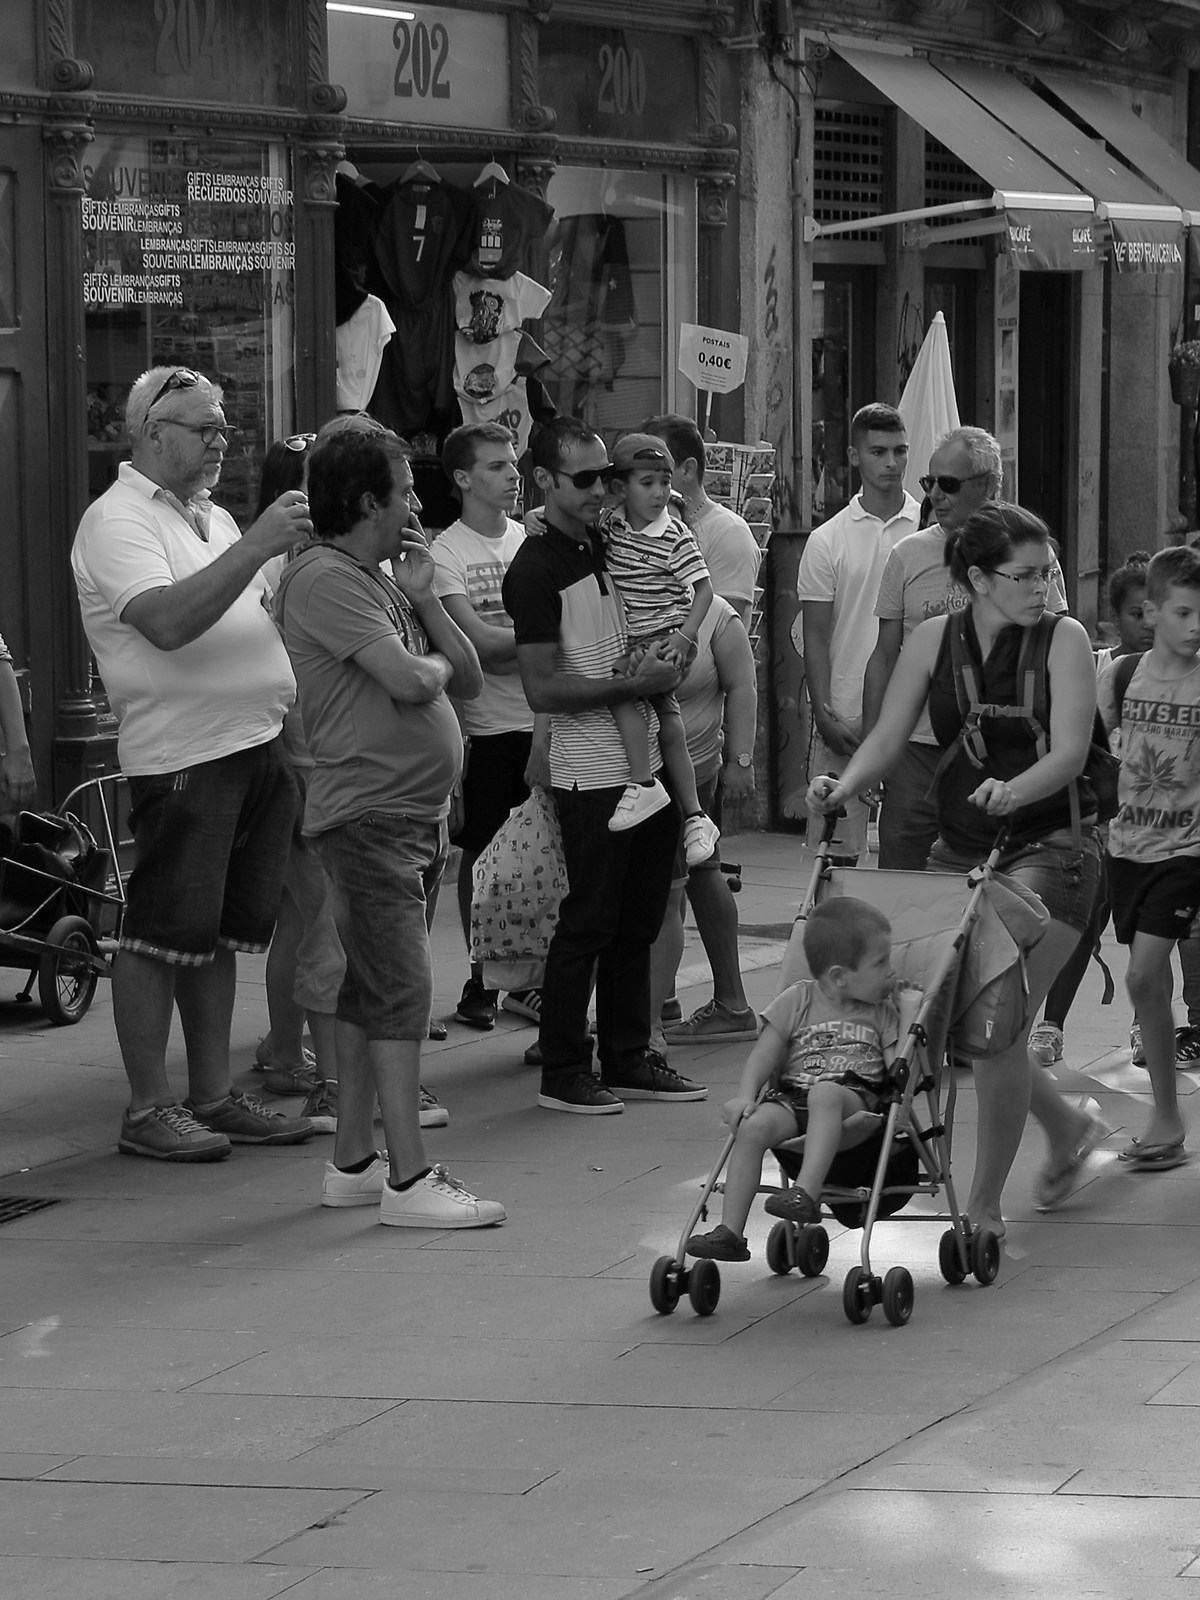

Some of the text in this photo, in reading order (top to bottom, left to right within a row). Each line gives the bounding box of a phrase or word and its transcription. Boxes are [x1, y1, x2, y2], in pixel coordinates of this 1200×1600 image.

[393, 21, 450, 98] 202
[598, 44, 646, 115] 200
[187, 172, 211, 187] GIFTS
[261, 176, 284, 191] GIFTS
[188, 186, 294, 206] RECUERDOS SOUVENIR
[81, 201, 108, 216] GIFTS
[82, 215, 134, 232] SOUVENIR
[413, 236, 425, 262] 7
[142, 254, 296, 275] SOUVENIR LEMBRANÇAS SOUVENIR
[83, 273, 108, 288] GIFTS
[83, 287, 134, 303] SOUVENIR
[703, 336, 730, 348] POSTAIS
[698, 351, 732, 370] 0,40€
